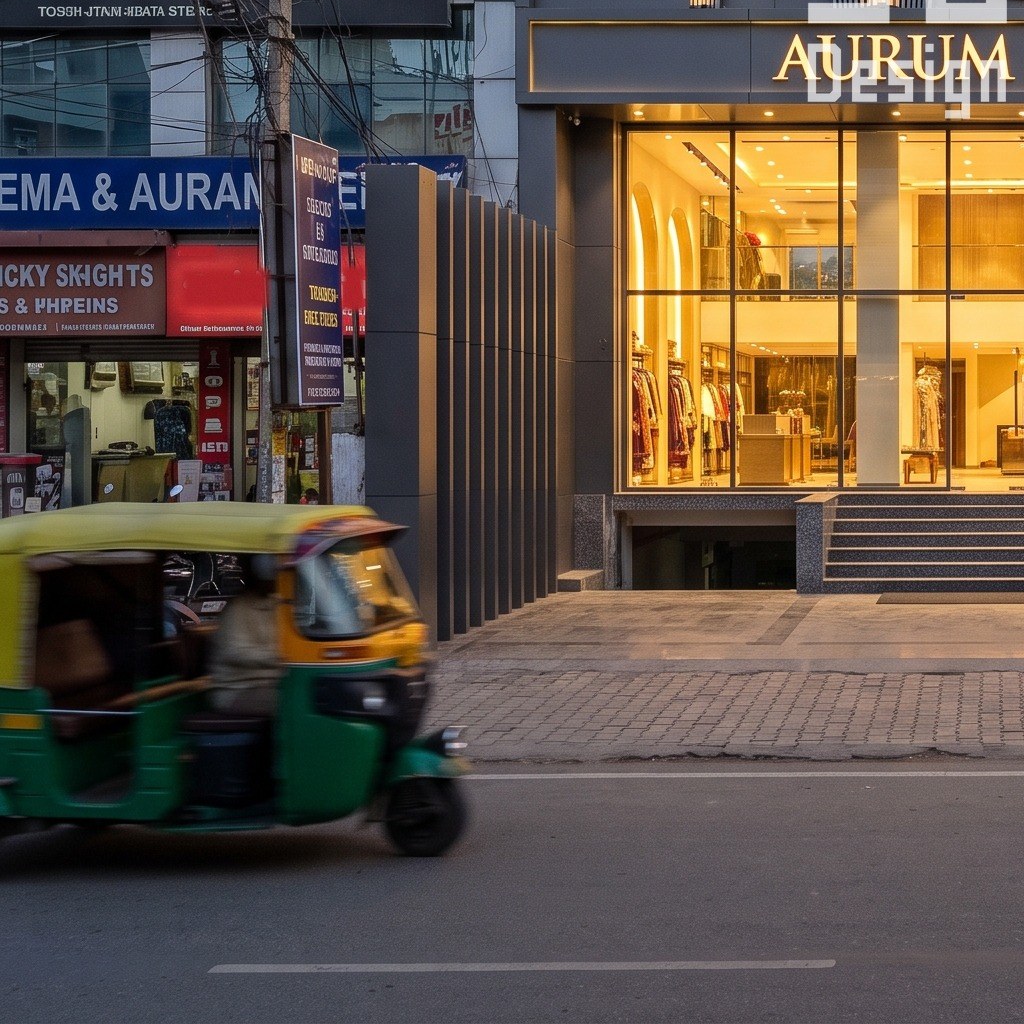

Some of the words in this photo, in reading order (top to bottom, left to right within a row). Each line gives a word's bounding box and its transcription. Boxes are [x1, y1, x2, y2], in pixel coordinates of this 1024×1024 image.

[772, 33, 1016, 82] AURUM
[91, 172, 119, 212] &
[14, 297, 28, 314] &
